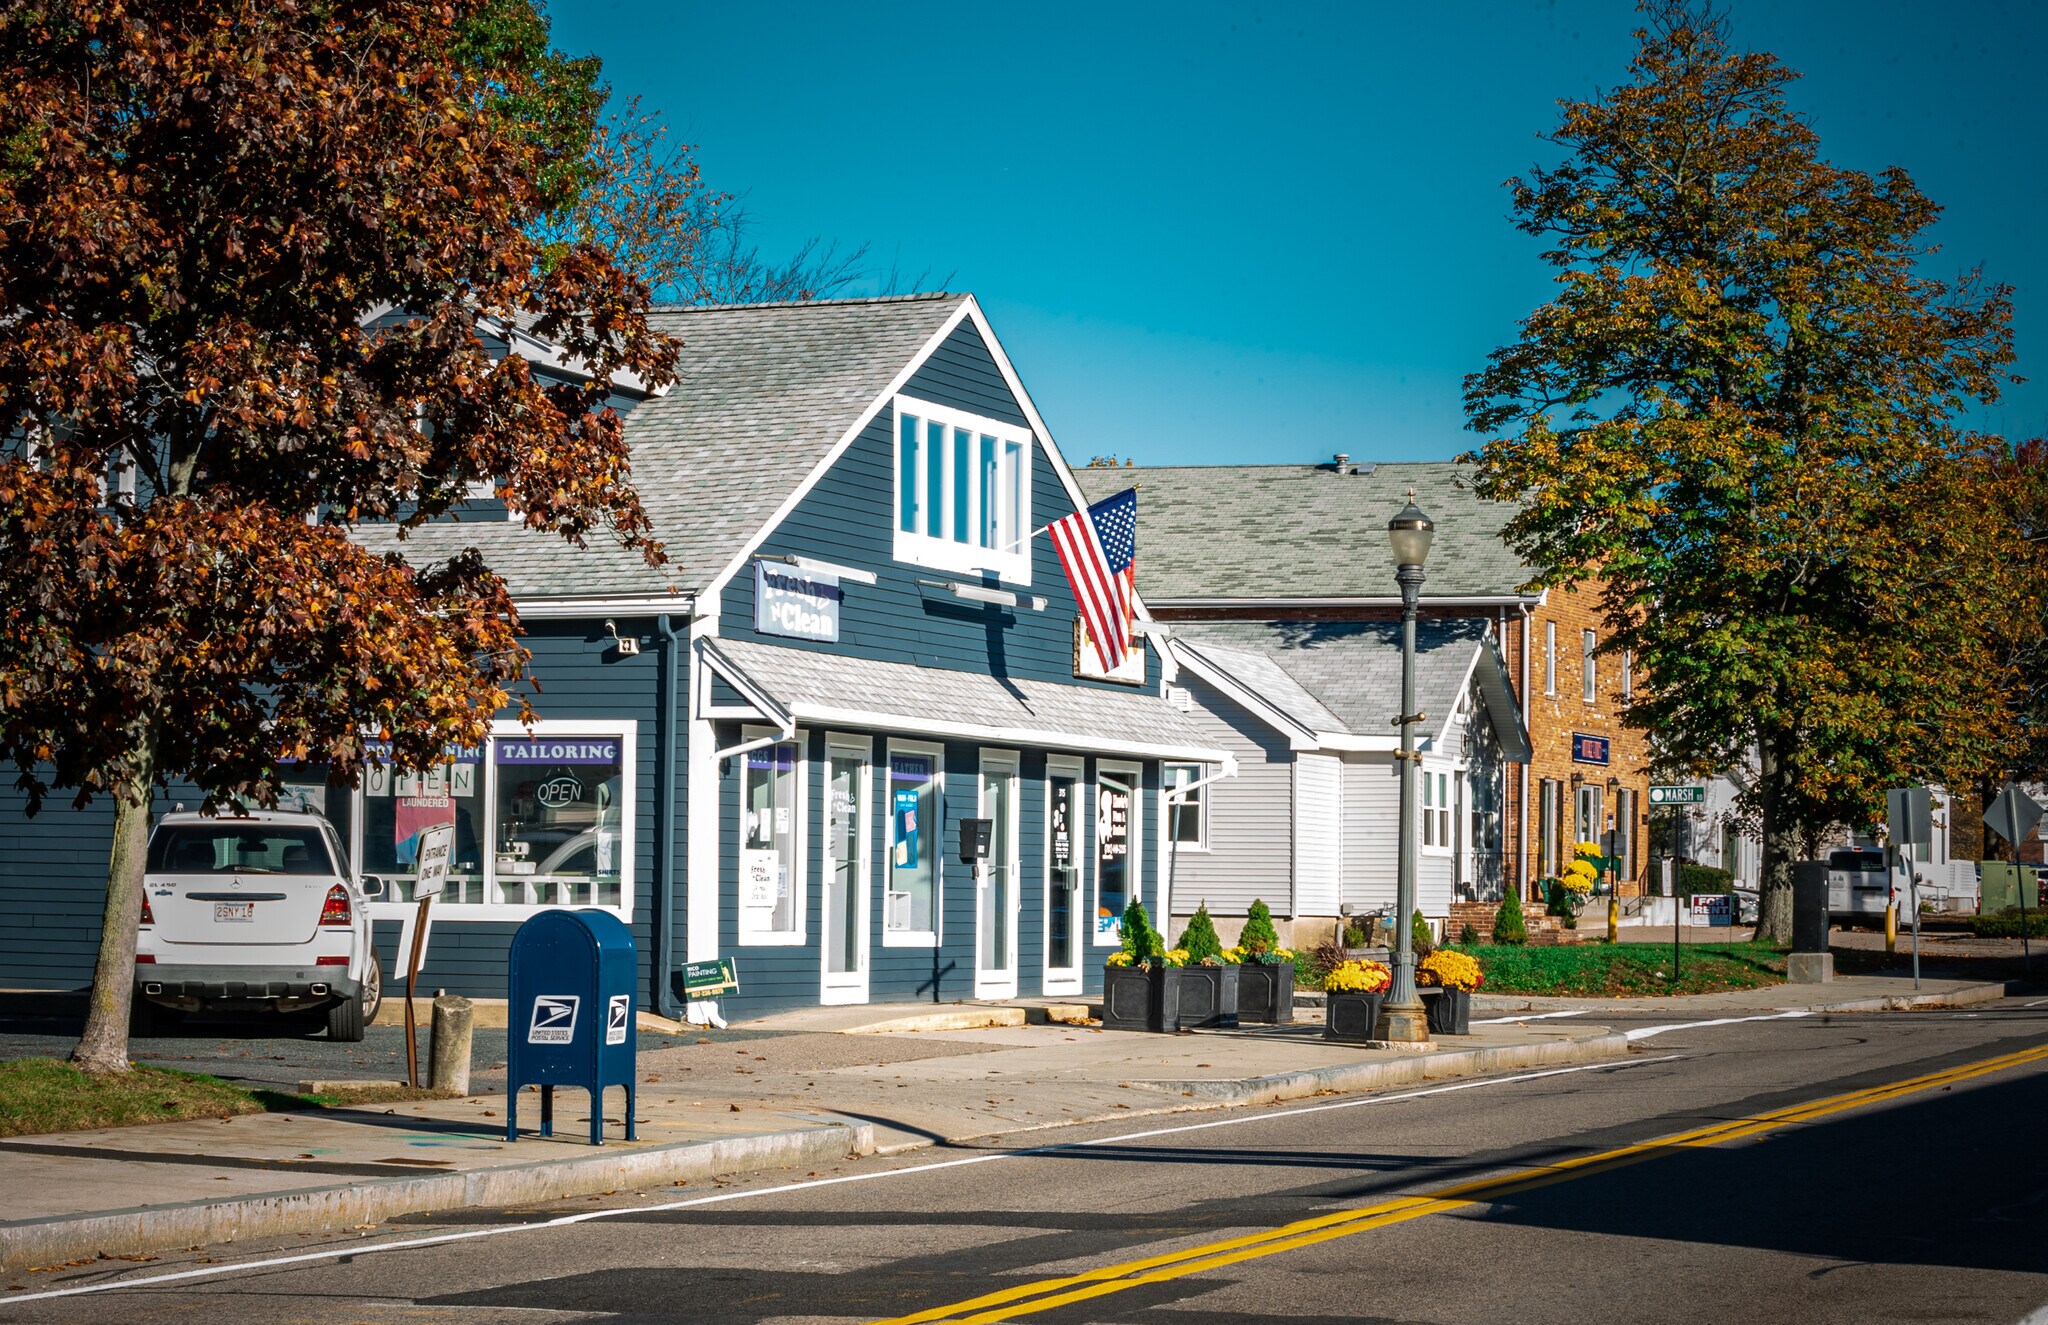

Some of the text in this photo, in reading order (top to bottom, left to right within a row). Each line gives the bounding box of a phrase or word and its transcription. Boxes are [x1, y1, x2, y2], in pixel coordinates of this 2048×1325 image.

[765, 568, 817, 607] Fresh
[781, 602, 833, 636] Clean
[503, 745, 618, 759] TAILORING
[537, 783, 581, 801] OPEN
[1665, 788, 1694, 801] MARSH
[401, 798, 449, 808] LAUNDERED
[836, 801, 856, 813] Clean
[424, 844, 448, 861] ENTRANCE
[421, 864, 444, 880] ONE WAY
[1698, 897, 1725, 906] FOR
[1694, 906, 1729, 914] RENT
[688, 968, 718, 978] PAINTING
